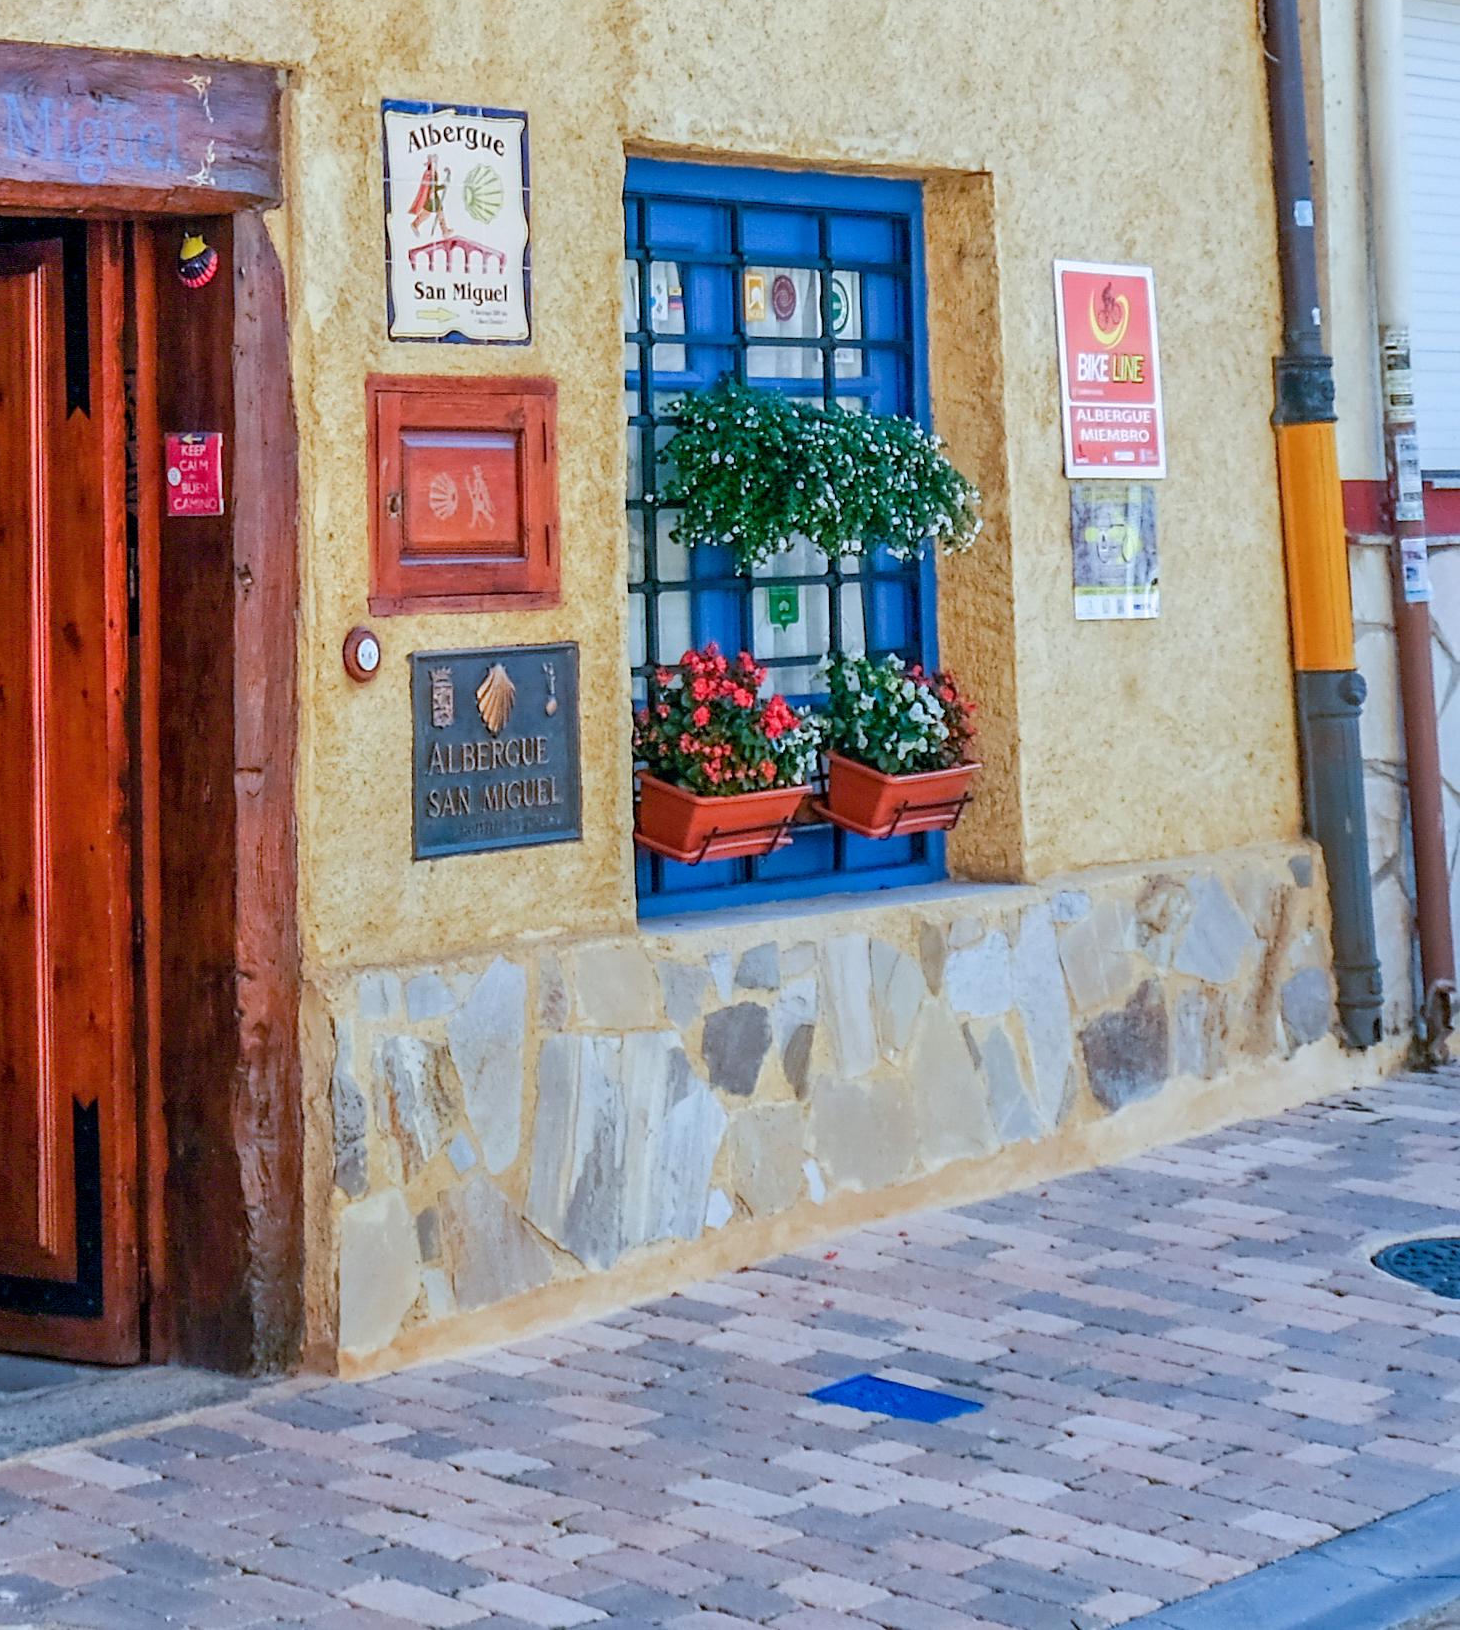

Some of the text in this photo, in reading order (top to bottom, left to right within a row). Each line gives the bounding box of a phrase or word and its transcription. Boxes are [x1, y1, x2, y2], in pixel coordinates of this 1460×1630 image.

[1, 92, 183, 184] Miguel
[408, 123, 506, 156] Albergue
[414, 281, 508, 306] San Miguel
[1077, 353, 1144, 384] BIKE LINE
[1076, 408, 1152, 424] ALBERGUE
[1080, 428, 1150, 443] MIEMBRO
[181, 444, 206, 457] KEEP
[179, 459, 209, 472] CALM
[181, 482, 208, 495] BUEN
[173, 497, 218, 511] CAMINO
[426, 736, 549, 776] ALBERGUE
[428, 775, 564, 818] SAN MIGUEL
